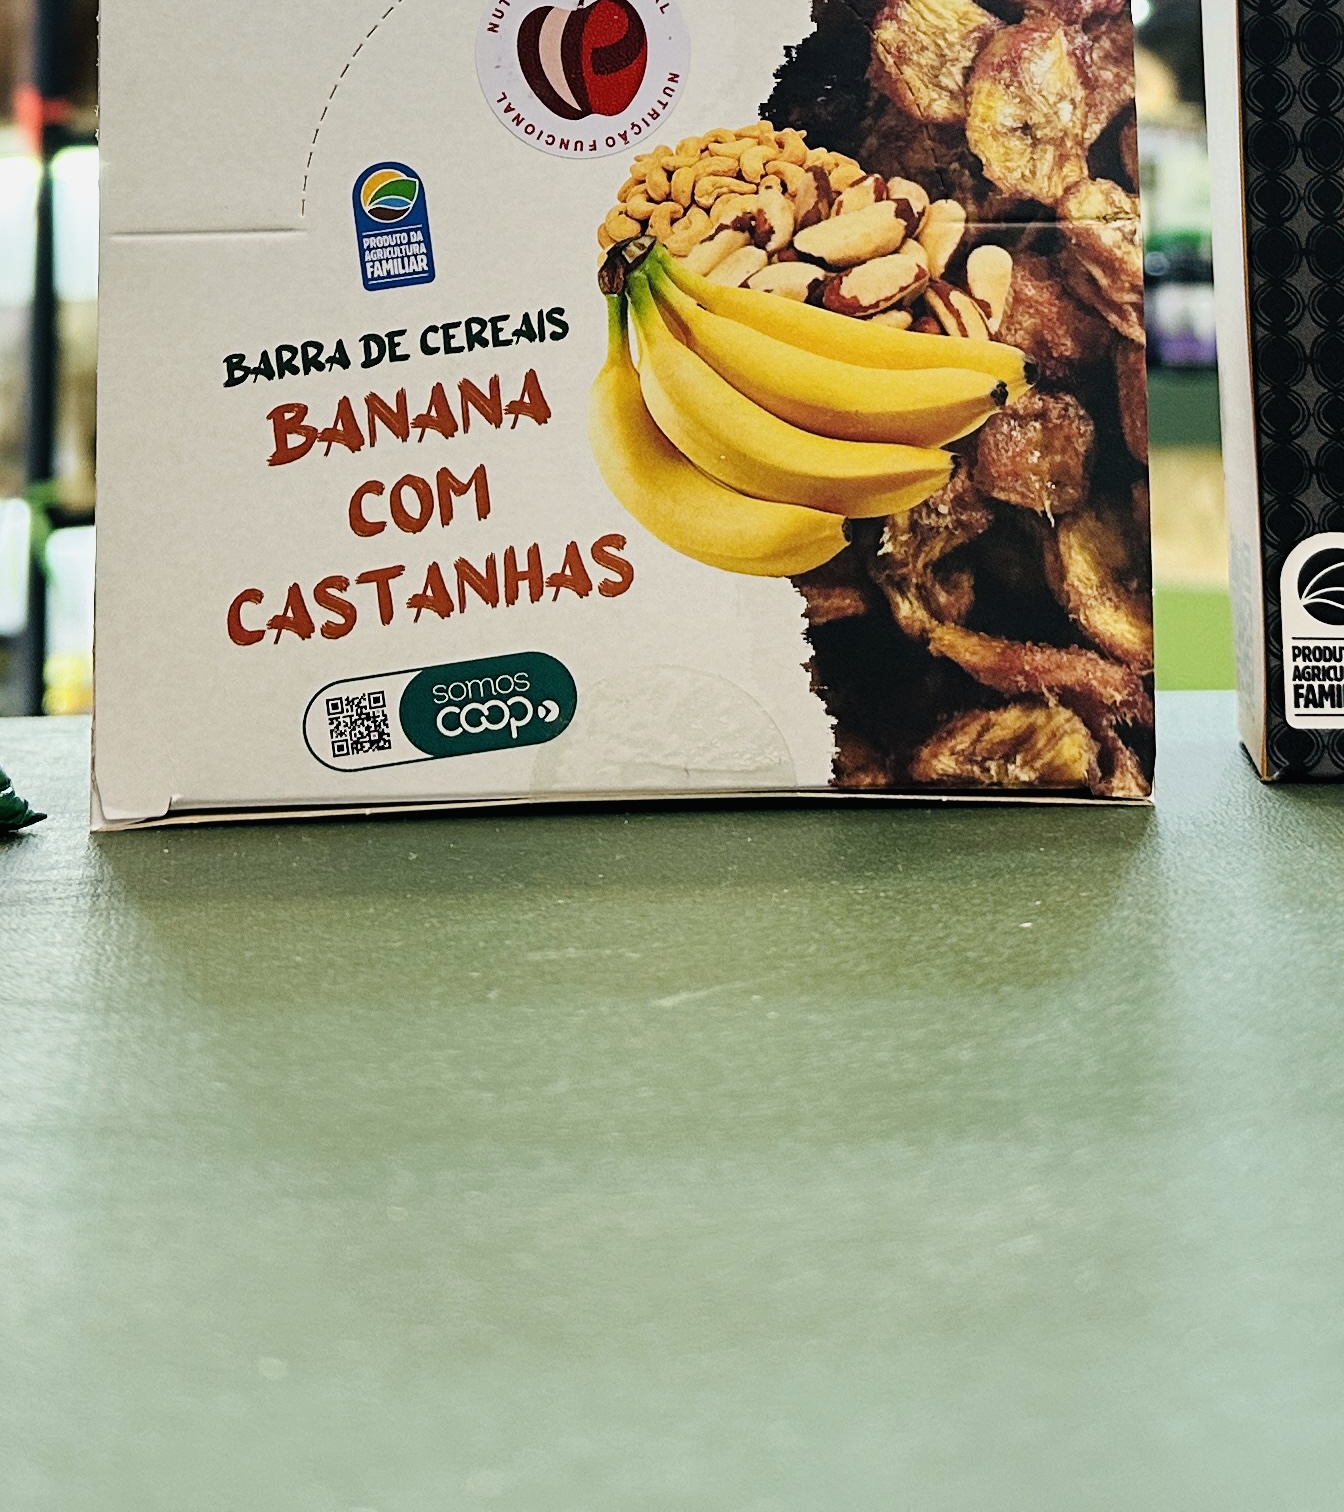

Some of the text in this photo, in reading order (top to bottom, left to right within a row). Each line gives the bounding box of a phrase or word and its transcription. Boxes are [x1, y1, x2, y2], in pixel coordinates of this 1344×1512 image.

[496, 71, 681, 152] NUTRIÇÃO FUNCIONAL
[362, 229, 424, 249] PRODUTO DA
[364, 242, 427, 261] AGRICULTURA
[365, 254, 429, 278] FAMILIAR
[223, 306, 570, 388] BARRA DE CEREAIS
[266, 368, 552, 467] BANANA
[348, 463, 491, 538] COM
[226, 533, 635, 647] CASTANHAS
[432, 672, 531, 704] somos
[436, 695, 534, 739] coop
